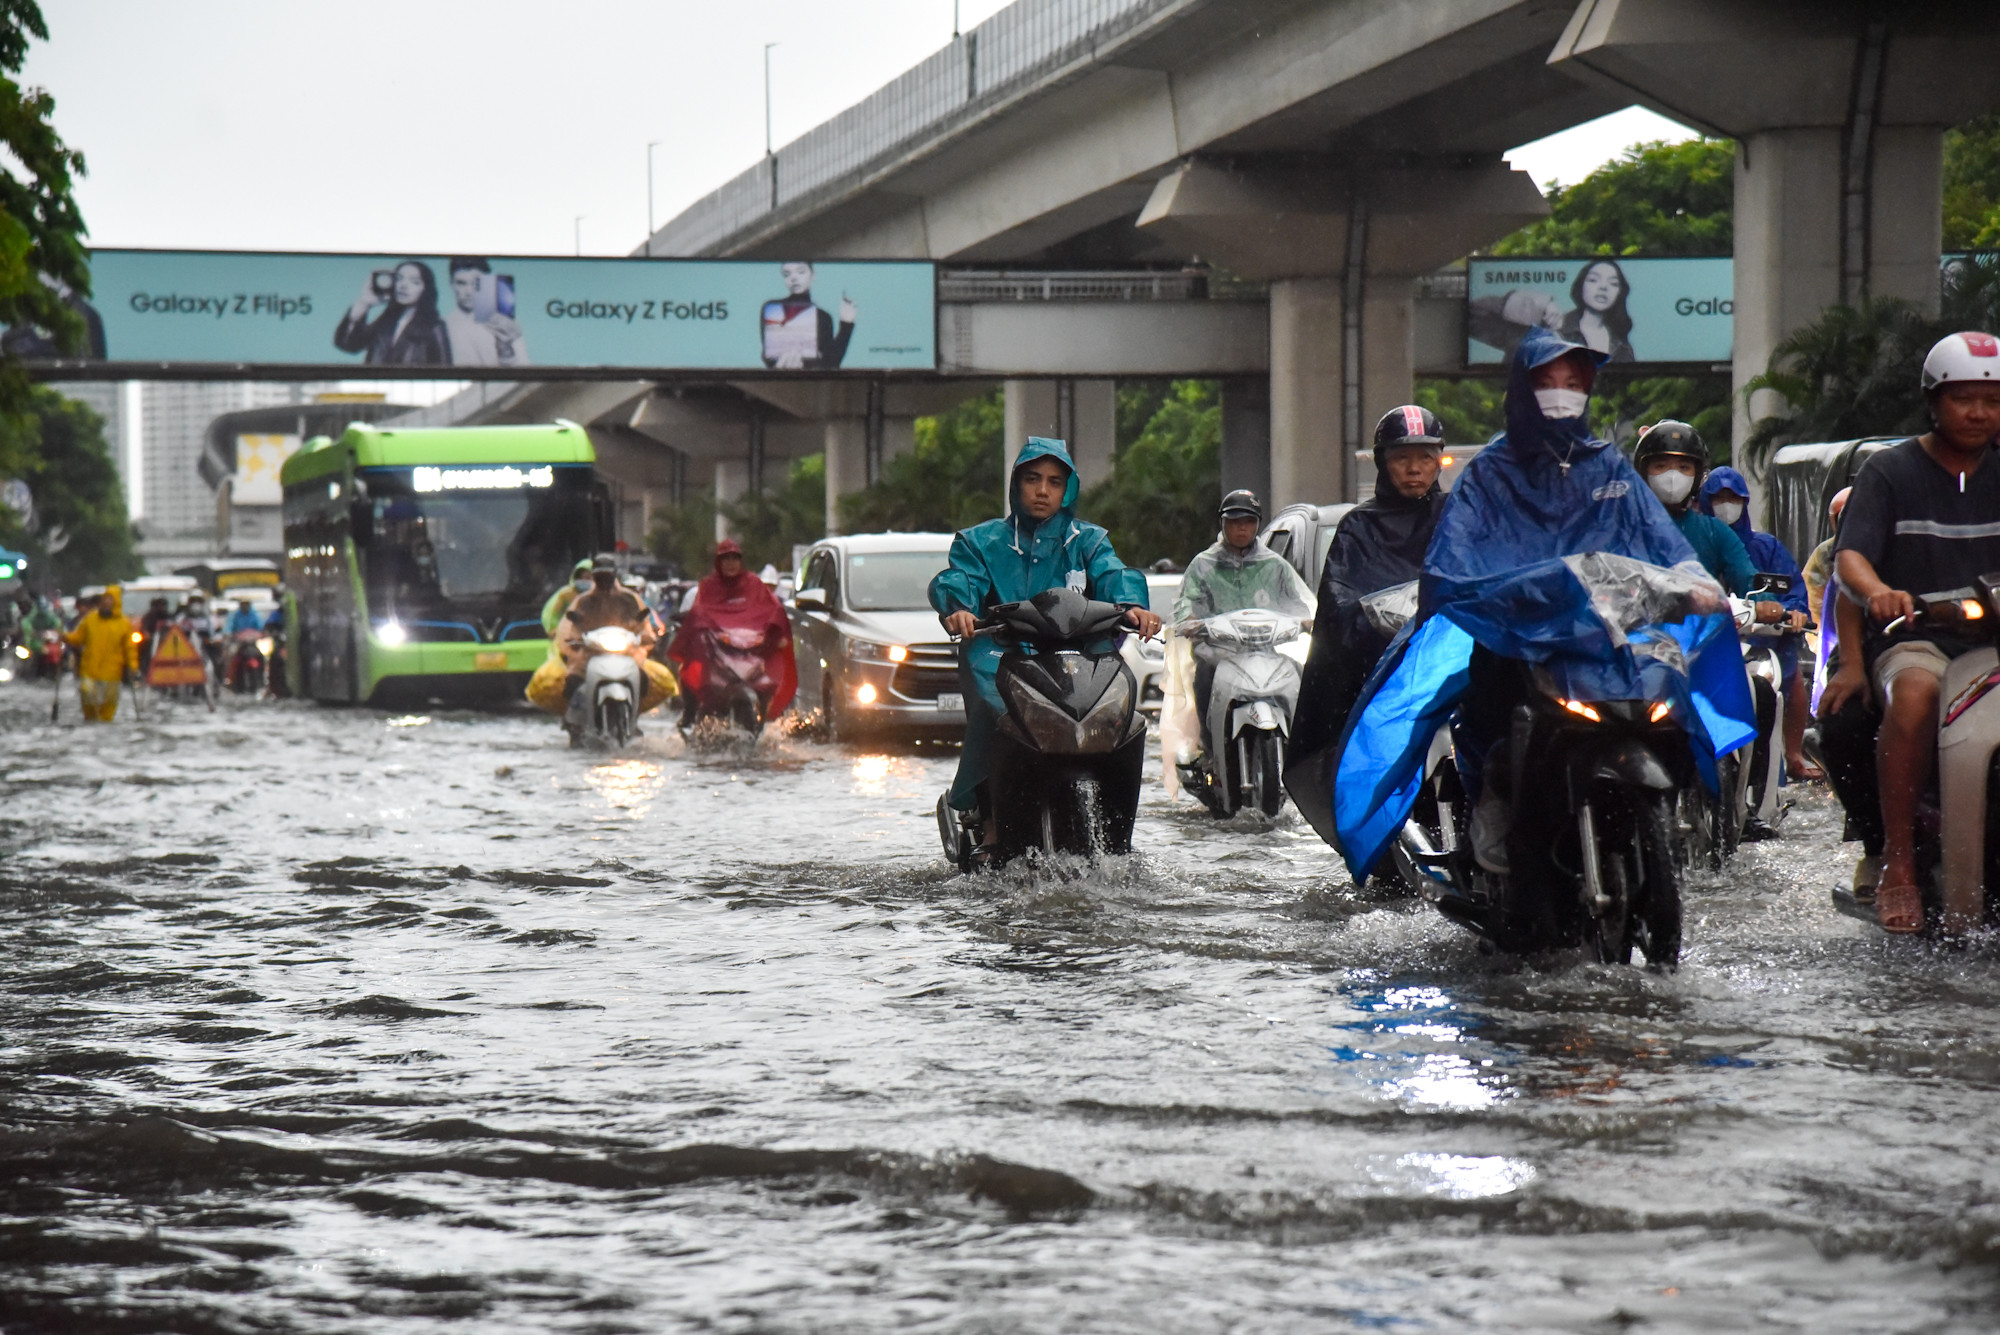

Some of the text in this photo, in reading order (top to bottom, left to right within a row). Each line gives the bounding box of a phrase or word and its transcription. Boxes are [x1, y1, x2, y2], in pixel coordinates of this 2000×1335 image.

[1484, 271, 1567, 284] SAMSUNG
[130, 292, 313, 320] Galaxy Z Flip5
[546, 299, 729, 325] Galaxy Z Fold5
